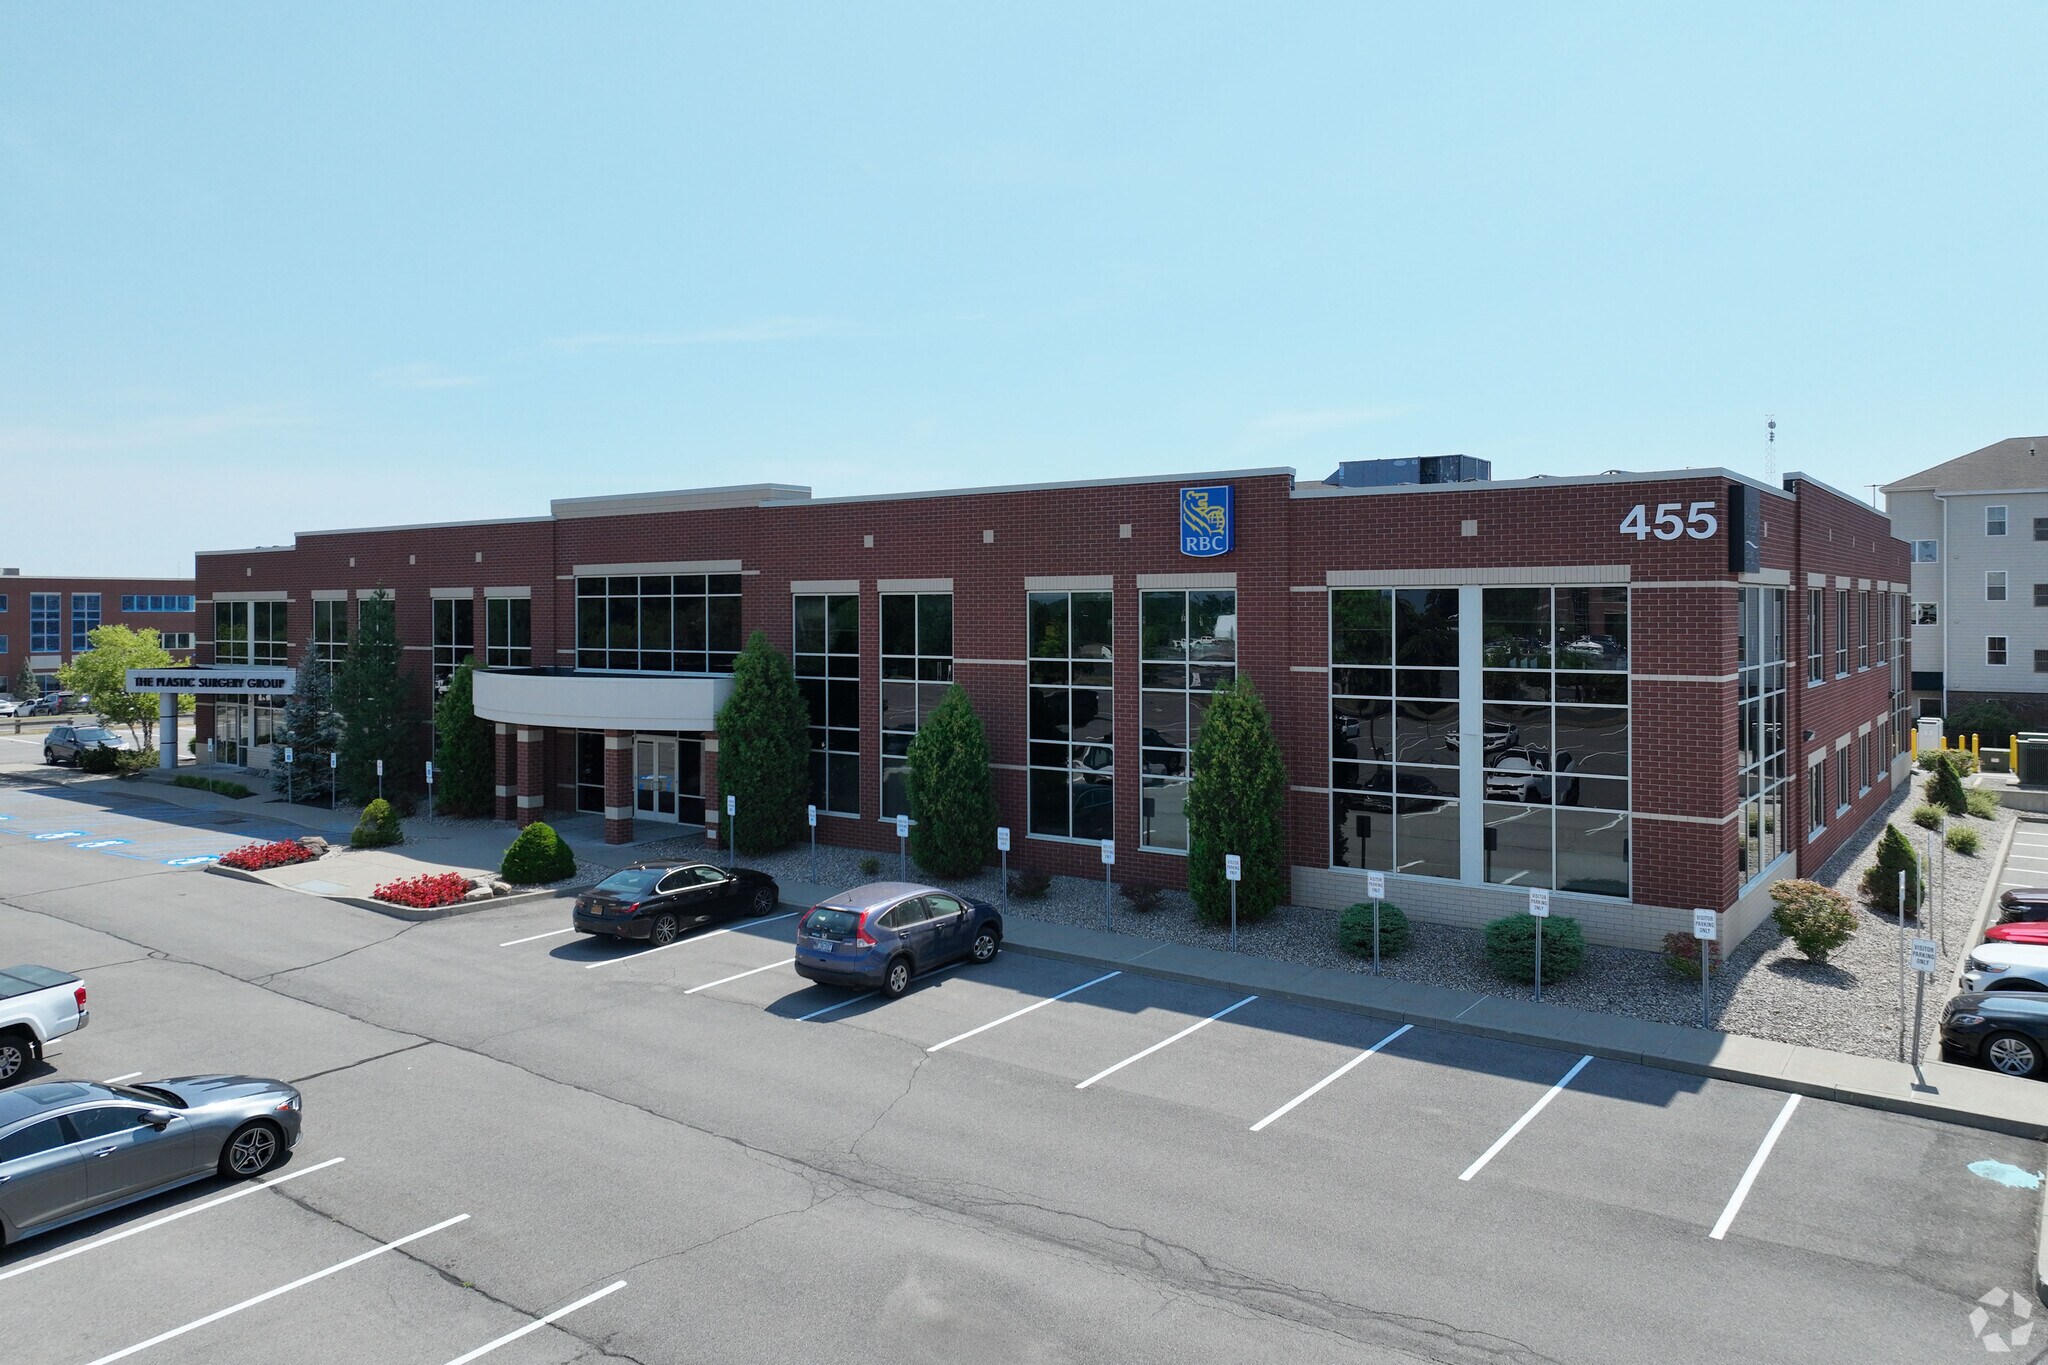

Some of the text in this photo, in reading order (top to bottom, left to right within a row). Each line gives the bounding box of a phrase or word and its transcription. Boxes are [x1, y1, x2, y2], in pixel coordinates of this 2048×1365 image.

[1619, 501, 1718, 541] 455
[1186, 535, 1223, 551] RBC
[134, 676, 285, 689] THE PLASTIC SURGERY GROUP
[1912, 951, 1935, 960] PARKING
[1914, 945, 1934, 953] VISITOR
